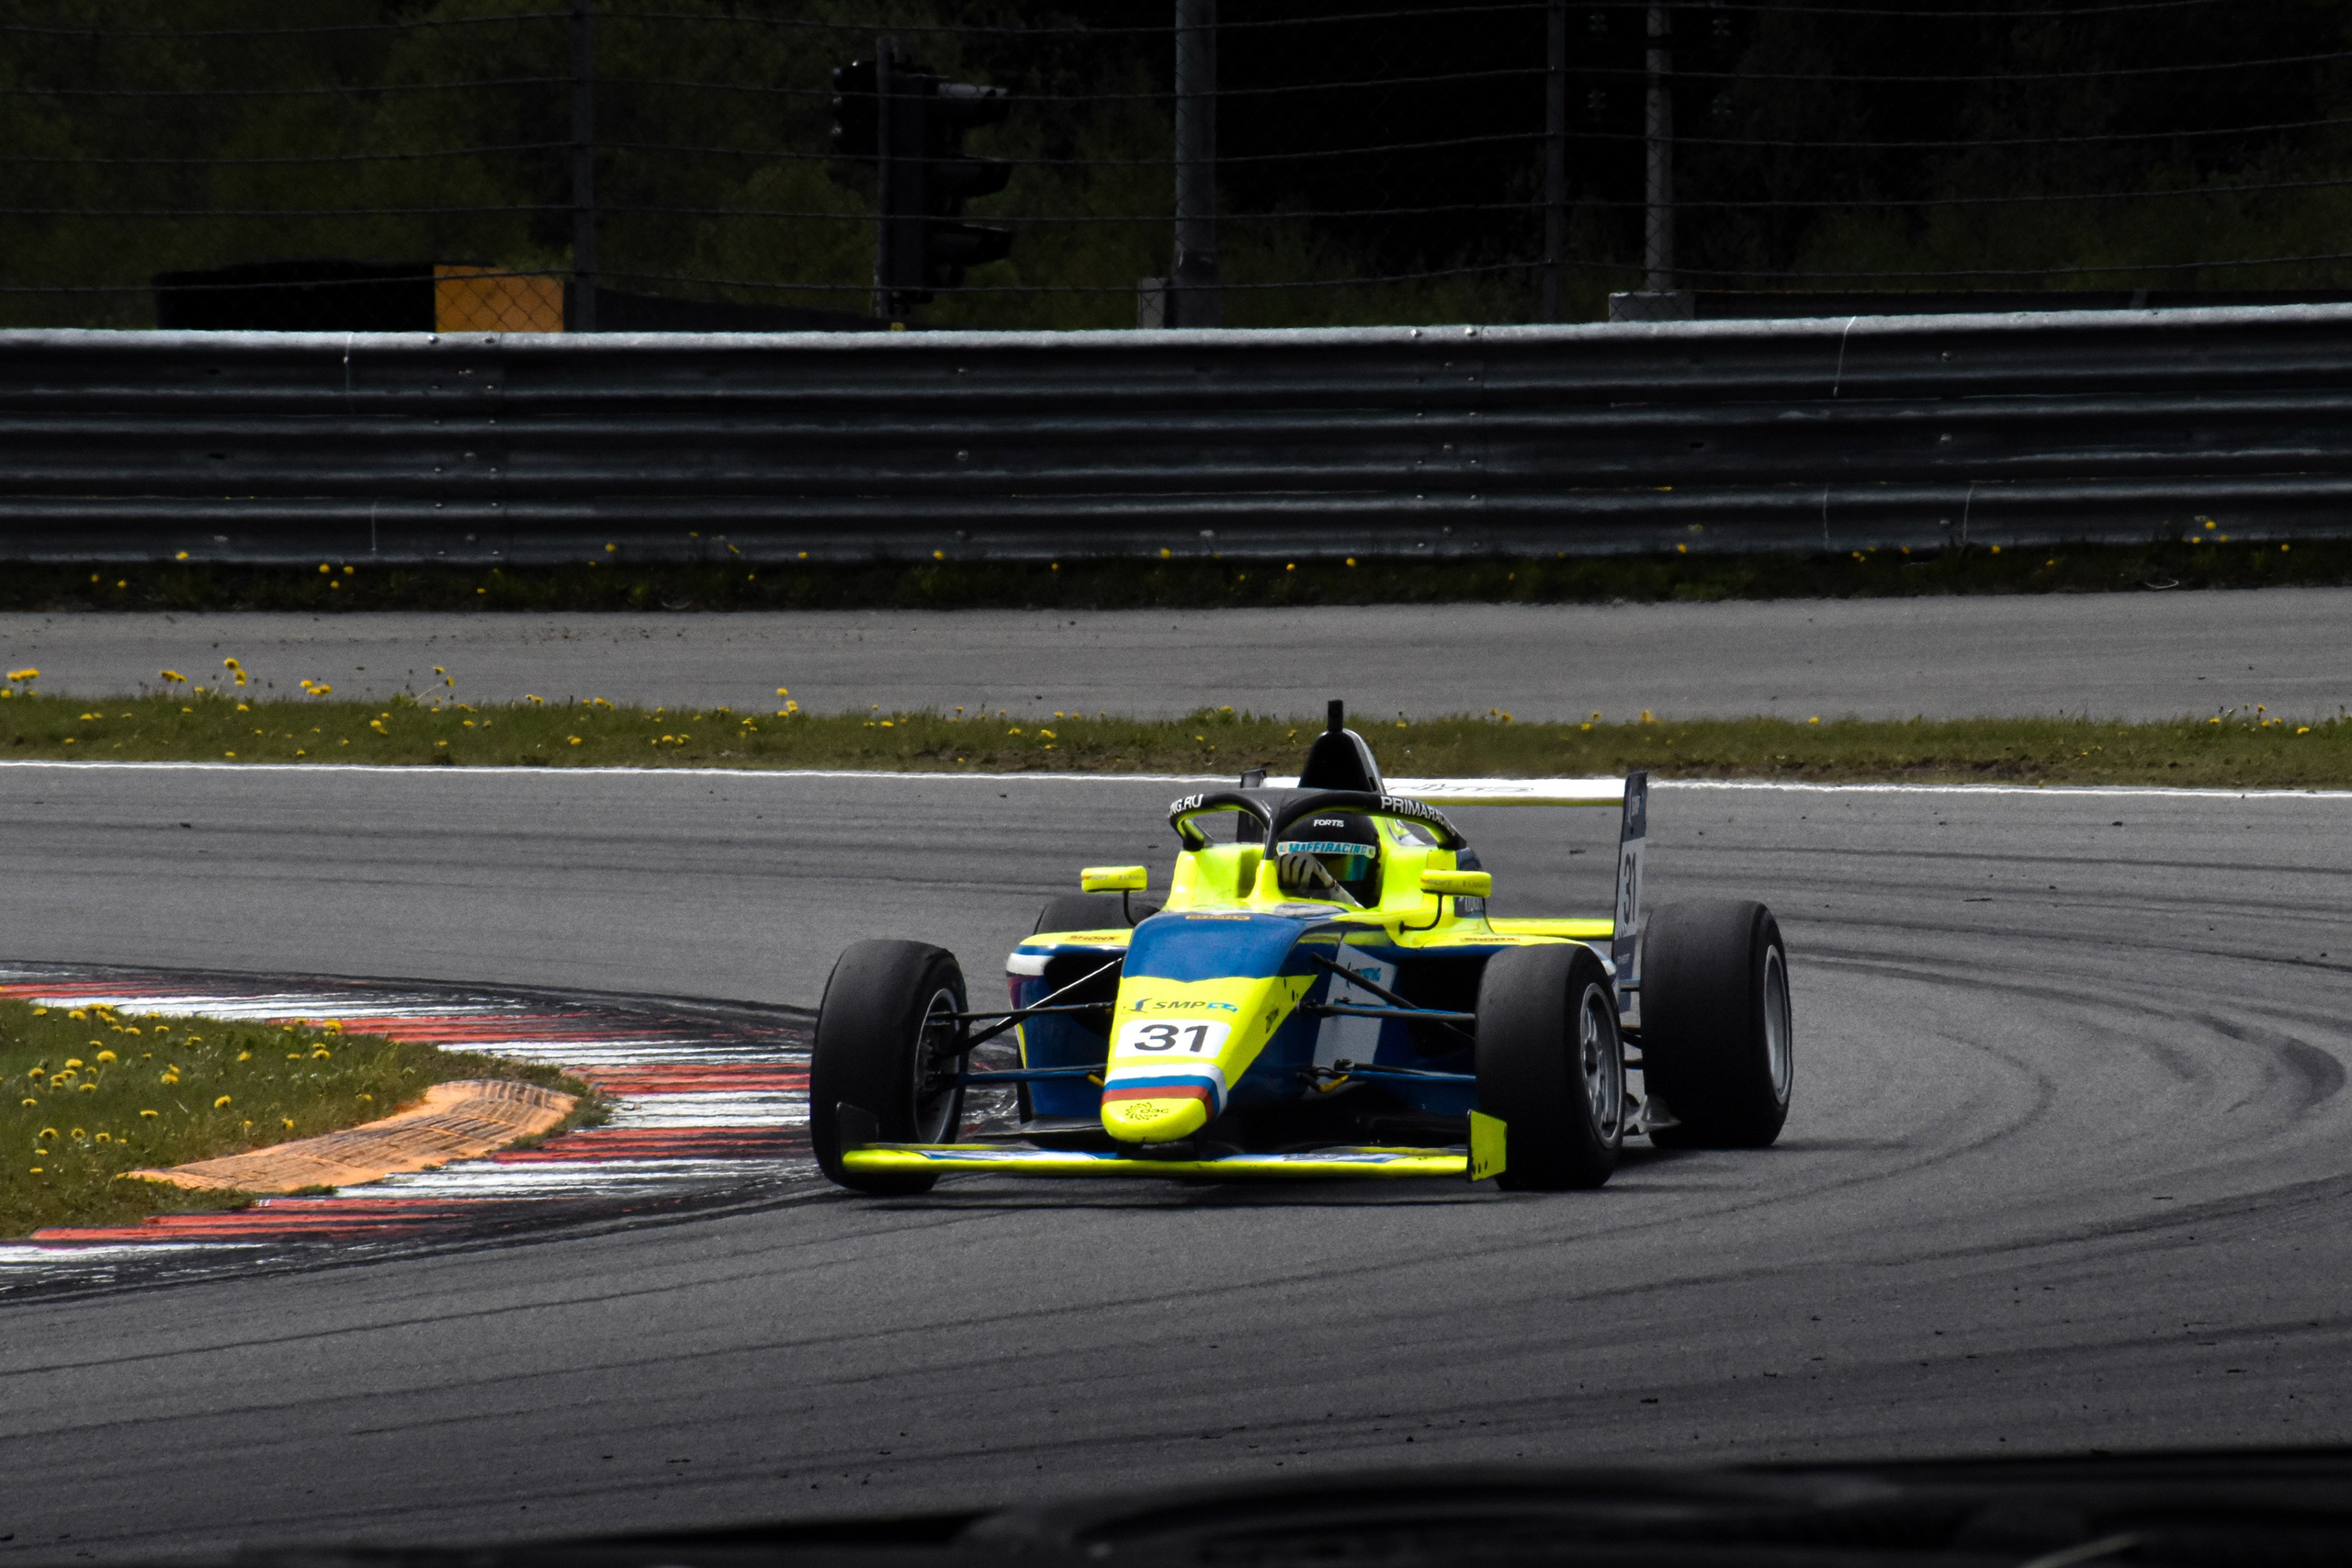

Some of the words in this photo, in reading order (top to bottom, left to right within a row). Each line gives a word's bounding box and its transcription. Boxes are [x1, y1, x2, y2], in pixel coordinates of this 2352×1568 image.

[1313, 818, 1345, 828] FORTIS
[1623, 852, 1636, 925] 31
[1153, 1000, 1205, 1010] SMP
[1134, 1023, 1209, 1053] 31
